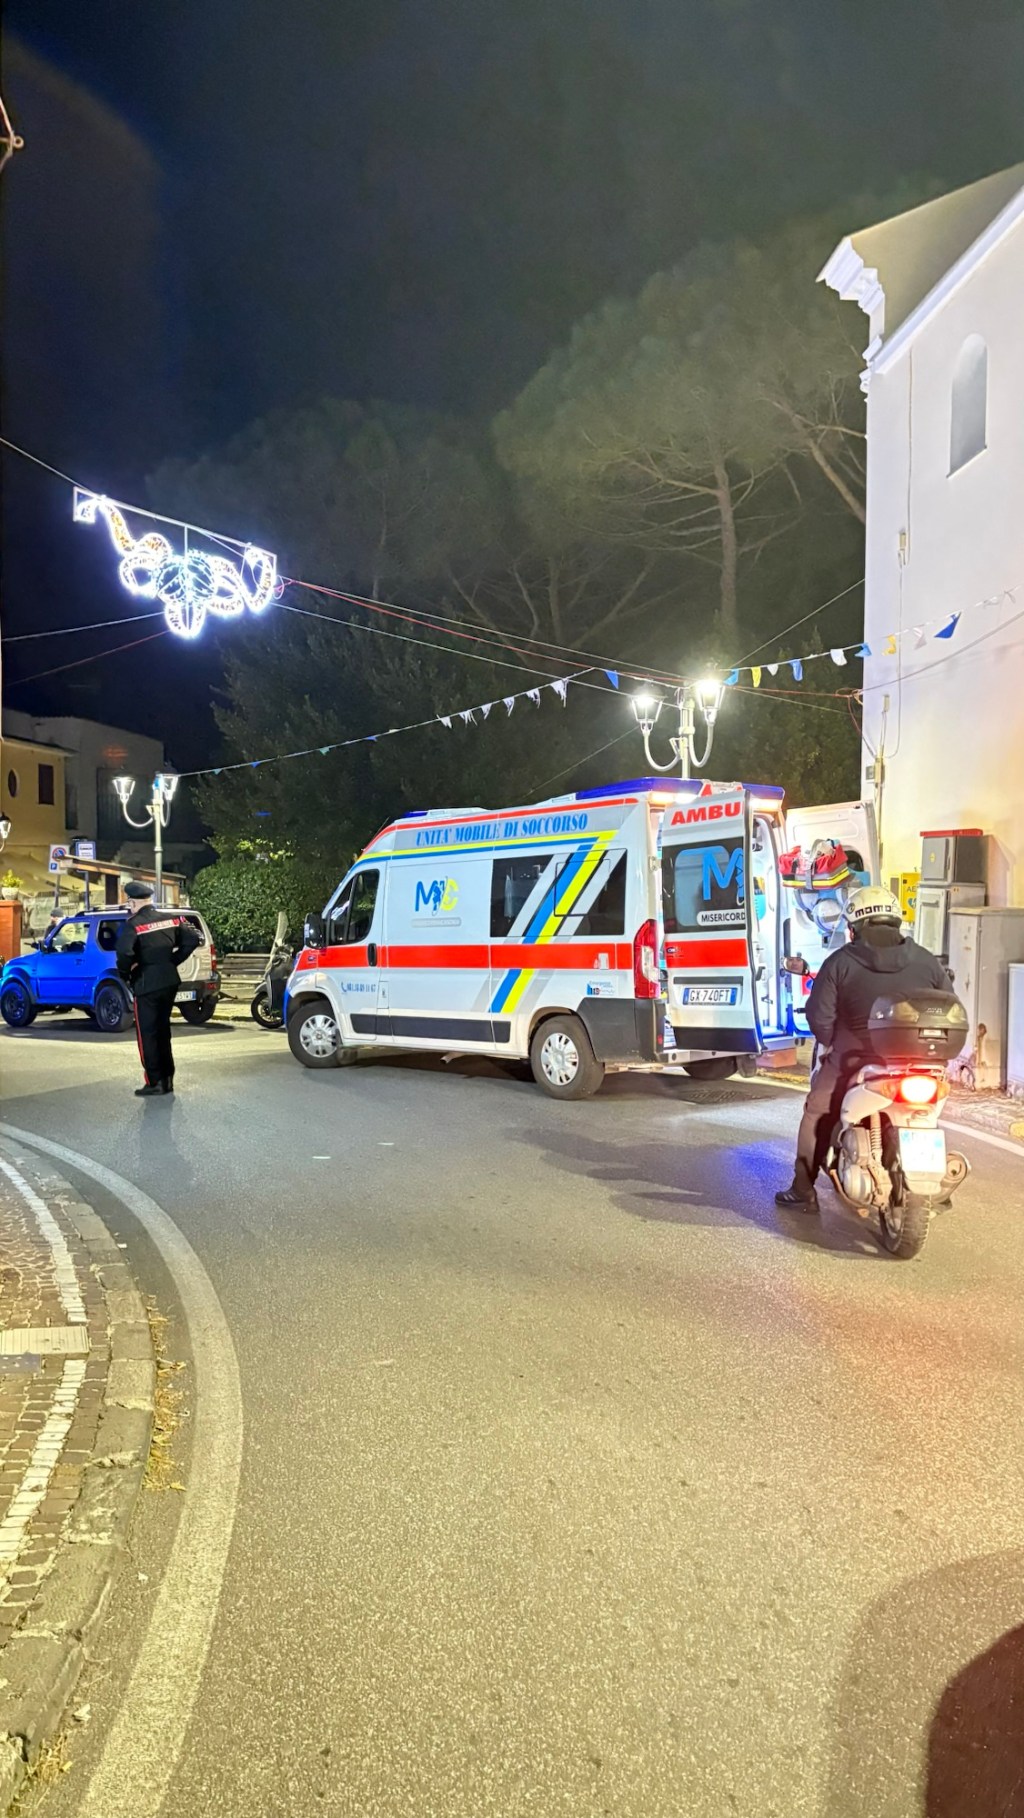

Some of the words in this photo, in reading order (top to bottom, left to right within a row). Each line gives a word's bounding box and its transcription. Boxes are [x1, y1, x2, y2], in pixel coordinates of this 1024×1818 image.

[671, 801, 744, 826] AMBU
[454, 823, 500, 844] MOBILE
[503, 821, 519, 838] DI
[521, 812, 588, 836] SOCCORSO
